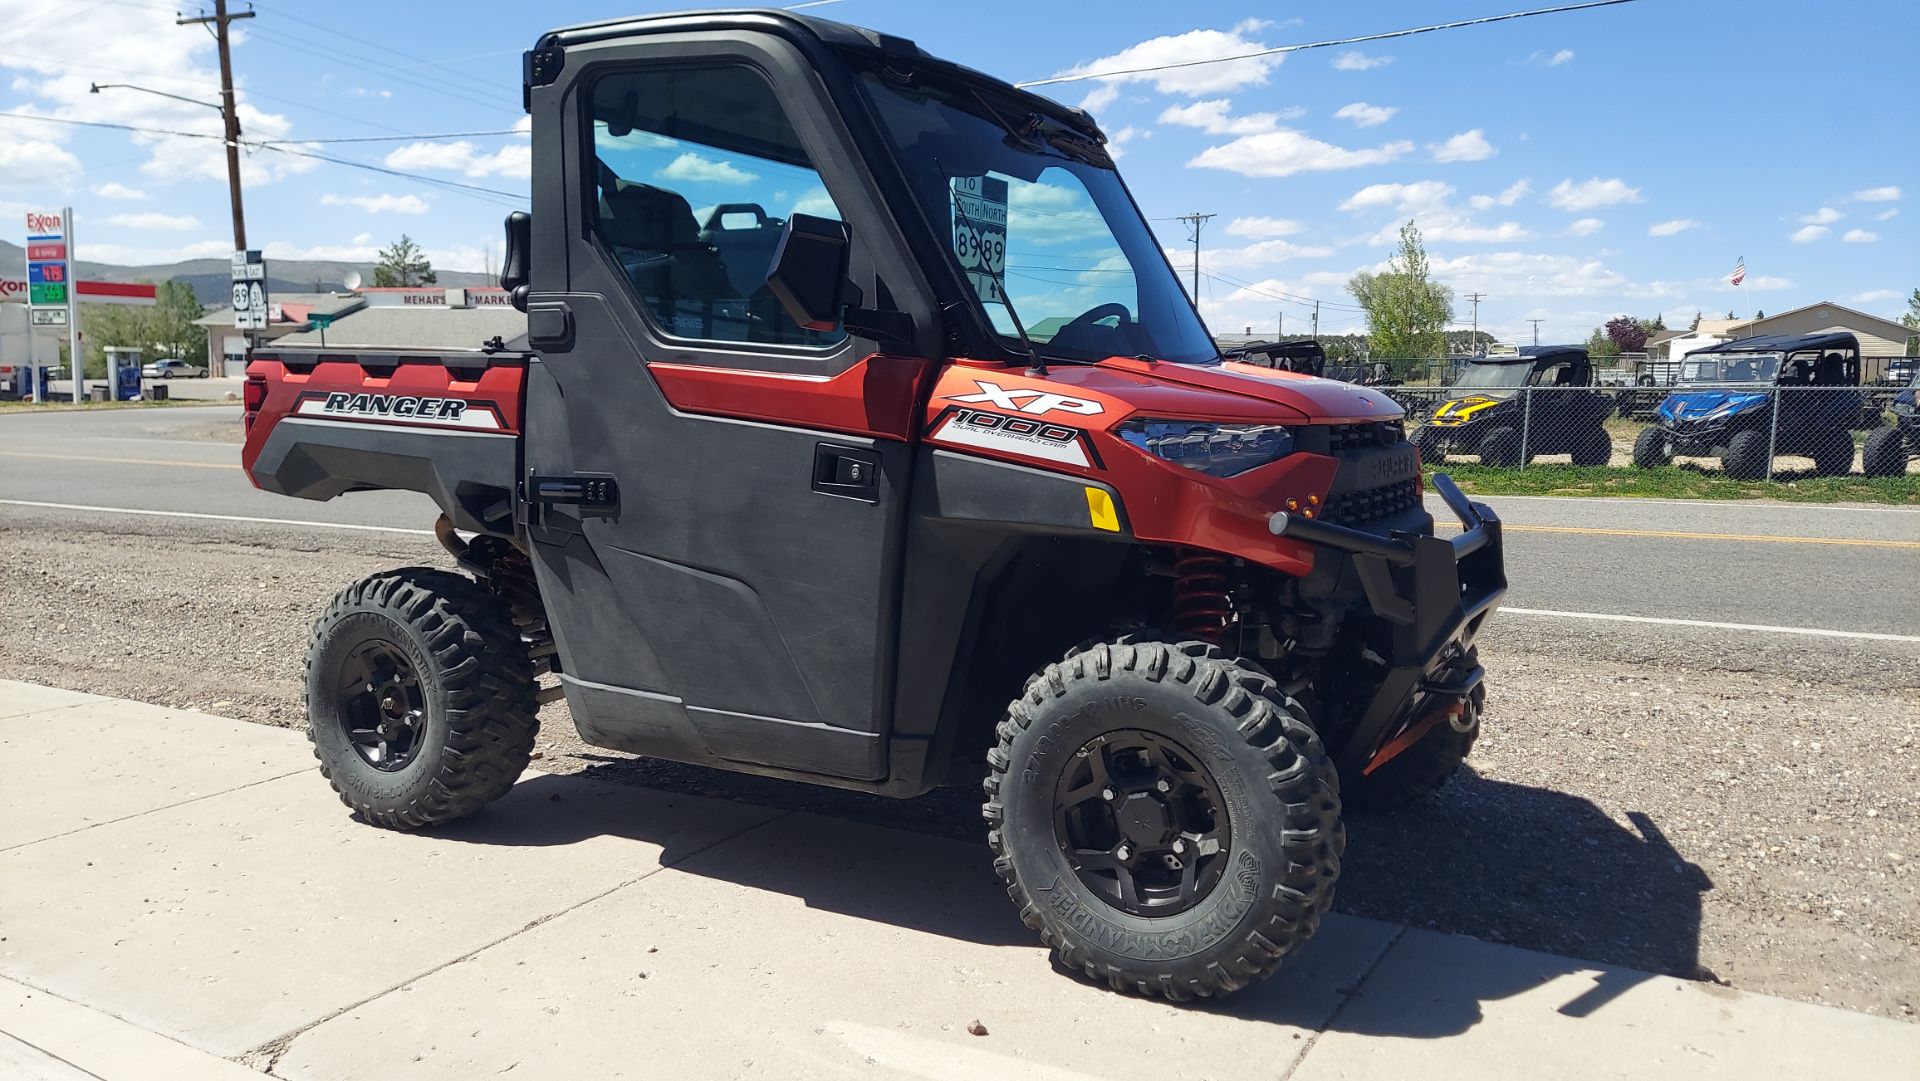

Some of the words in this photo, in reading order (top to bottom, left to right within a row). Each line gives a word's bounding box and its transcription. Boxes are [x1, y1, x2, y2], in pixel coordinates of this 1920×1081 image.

[962, 177, 976, 191] TO
[957, 198, 980, 217] SOUTH
[983, 203, 1006, 222] NORTH
[27, 213, 61, 233] Exxon
[958, 232, 979, 258] 89
[984, 239, 1003, 264] 89
[234, 289, 247, 303] 89
[404, 295, 446, 305] MEHAR'S
[475, 295, 512, 305] MARKE
[323, 391, 467, 420] RANGER
[939, 379, 1105, 416] XP
[952, 424, 979, 433] DUAL
[982, 429, 1041, 443] OVERHEAD
[1042, 441, 1067, 449] CAM
[953, 409, 1079, 444] 1000
